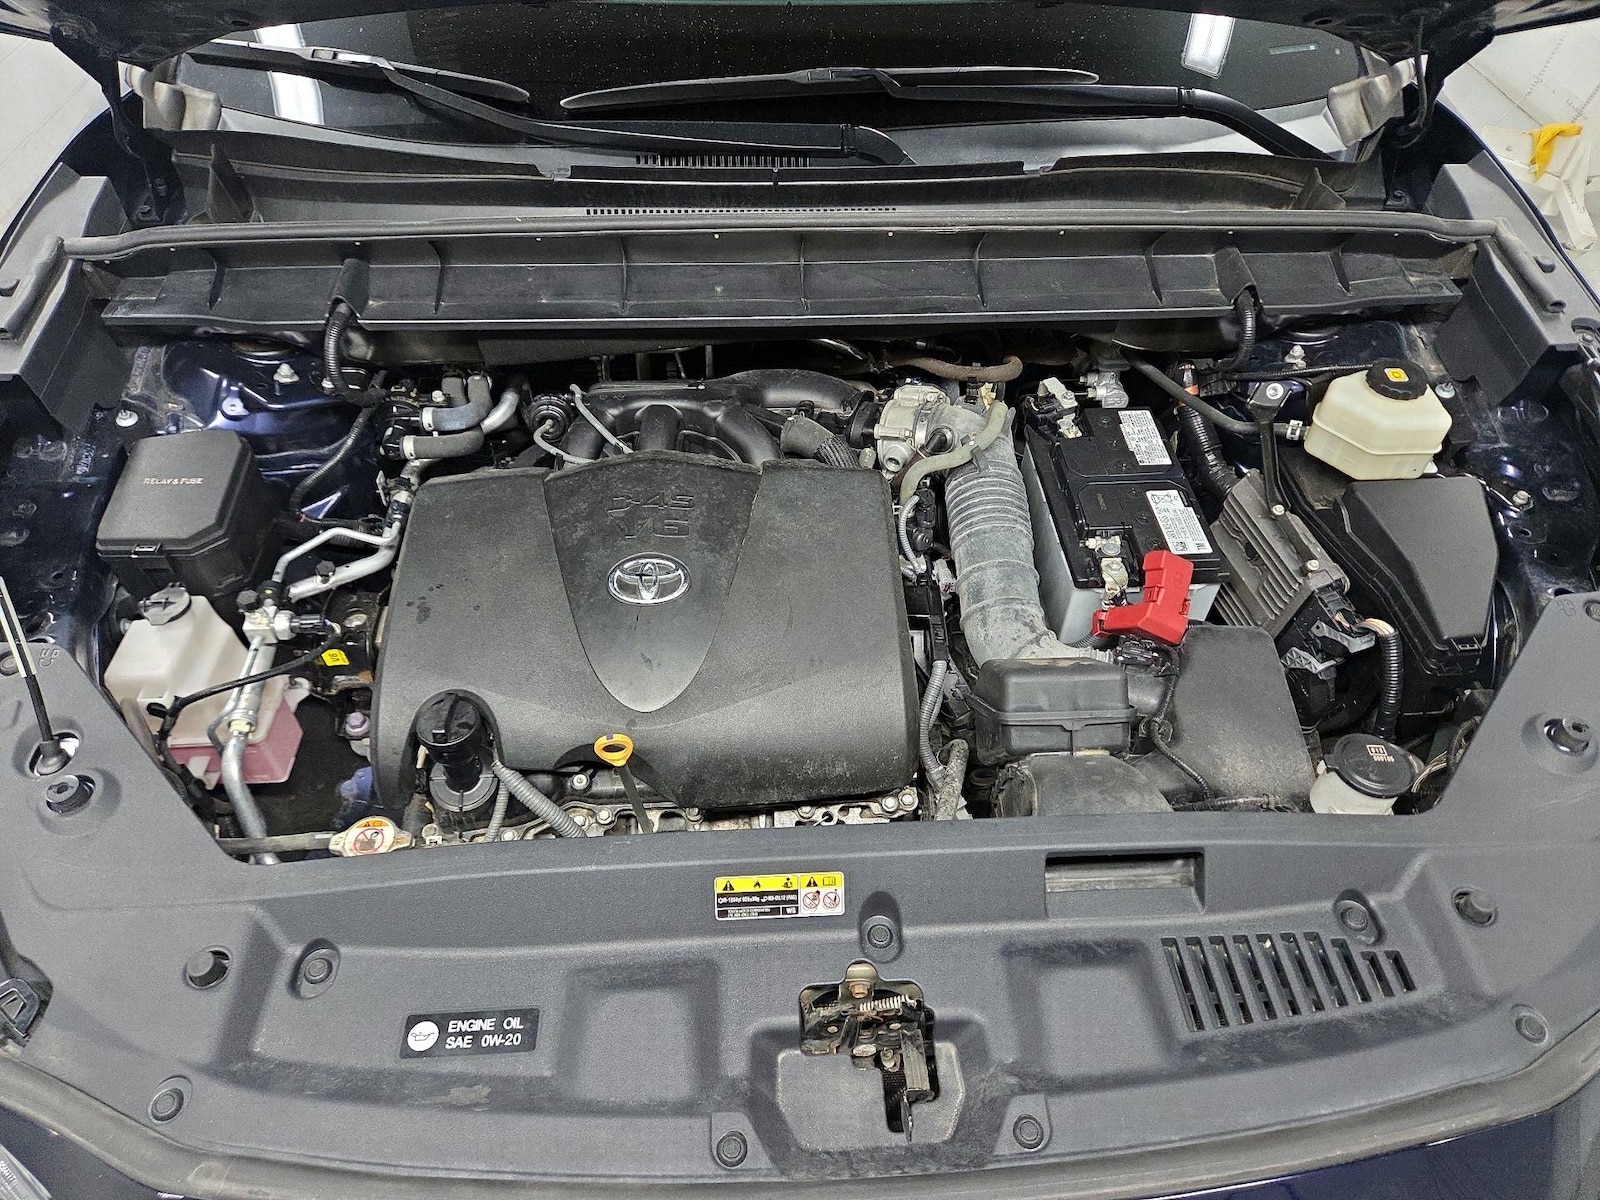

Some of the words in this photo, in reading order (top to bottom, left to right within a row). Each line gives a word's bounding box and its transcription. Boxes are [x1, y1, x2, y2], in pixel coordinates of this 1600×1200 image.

[609, 517, 690, 539] V6
[785, 907, 797, 915] WS
[447, 1018, 496, 1033] ENGINE
[503, 1017, 524, 1030] OIL
[445, 1035, 473, 1050] SAE
[481, 1033, 522, 1048] 0W-20
